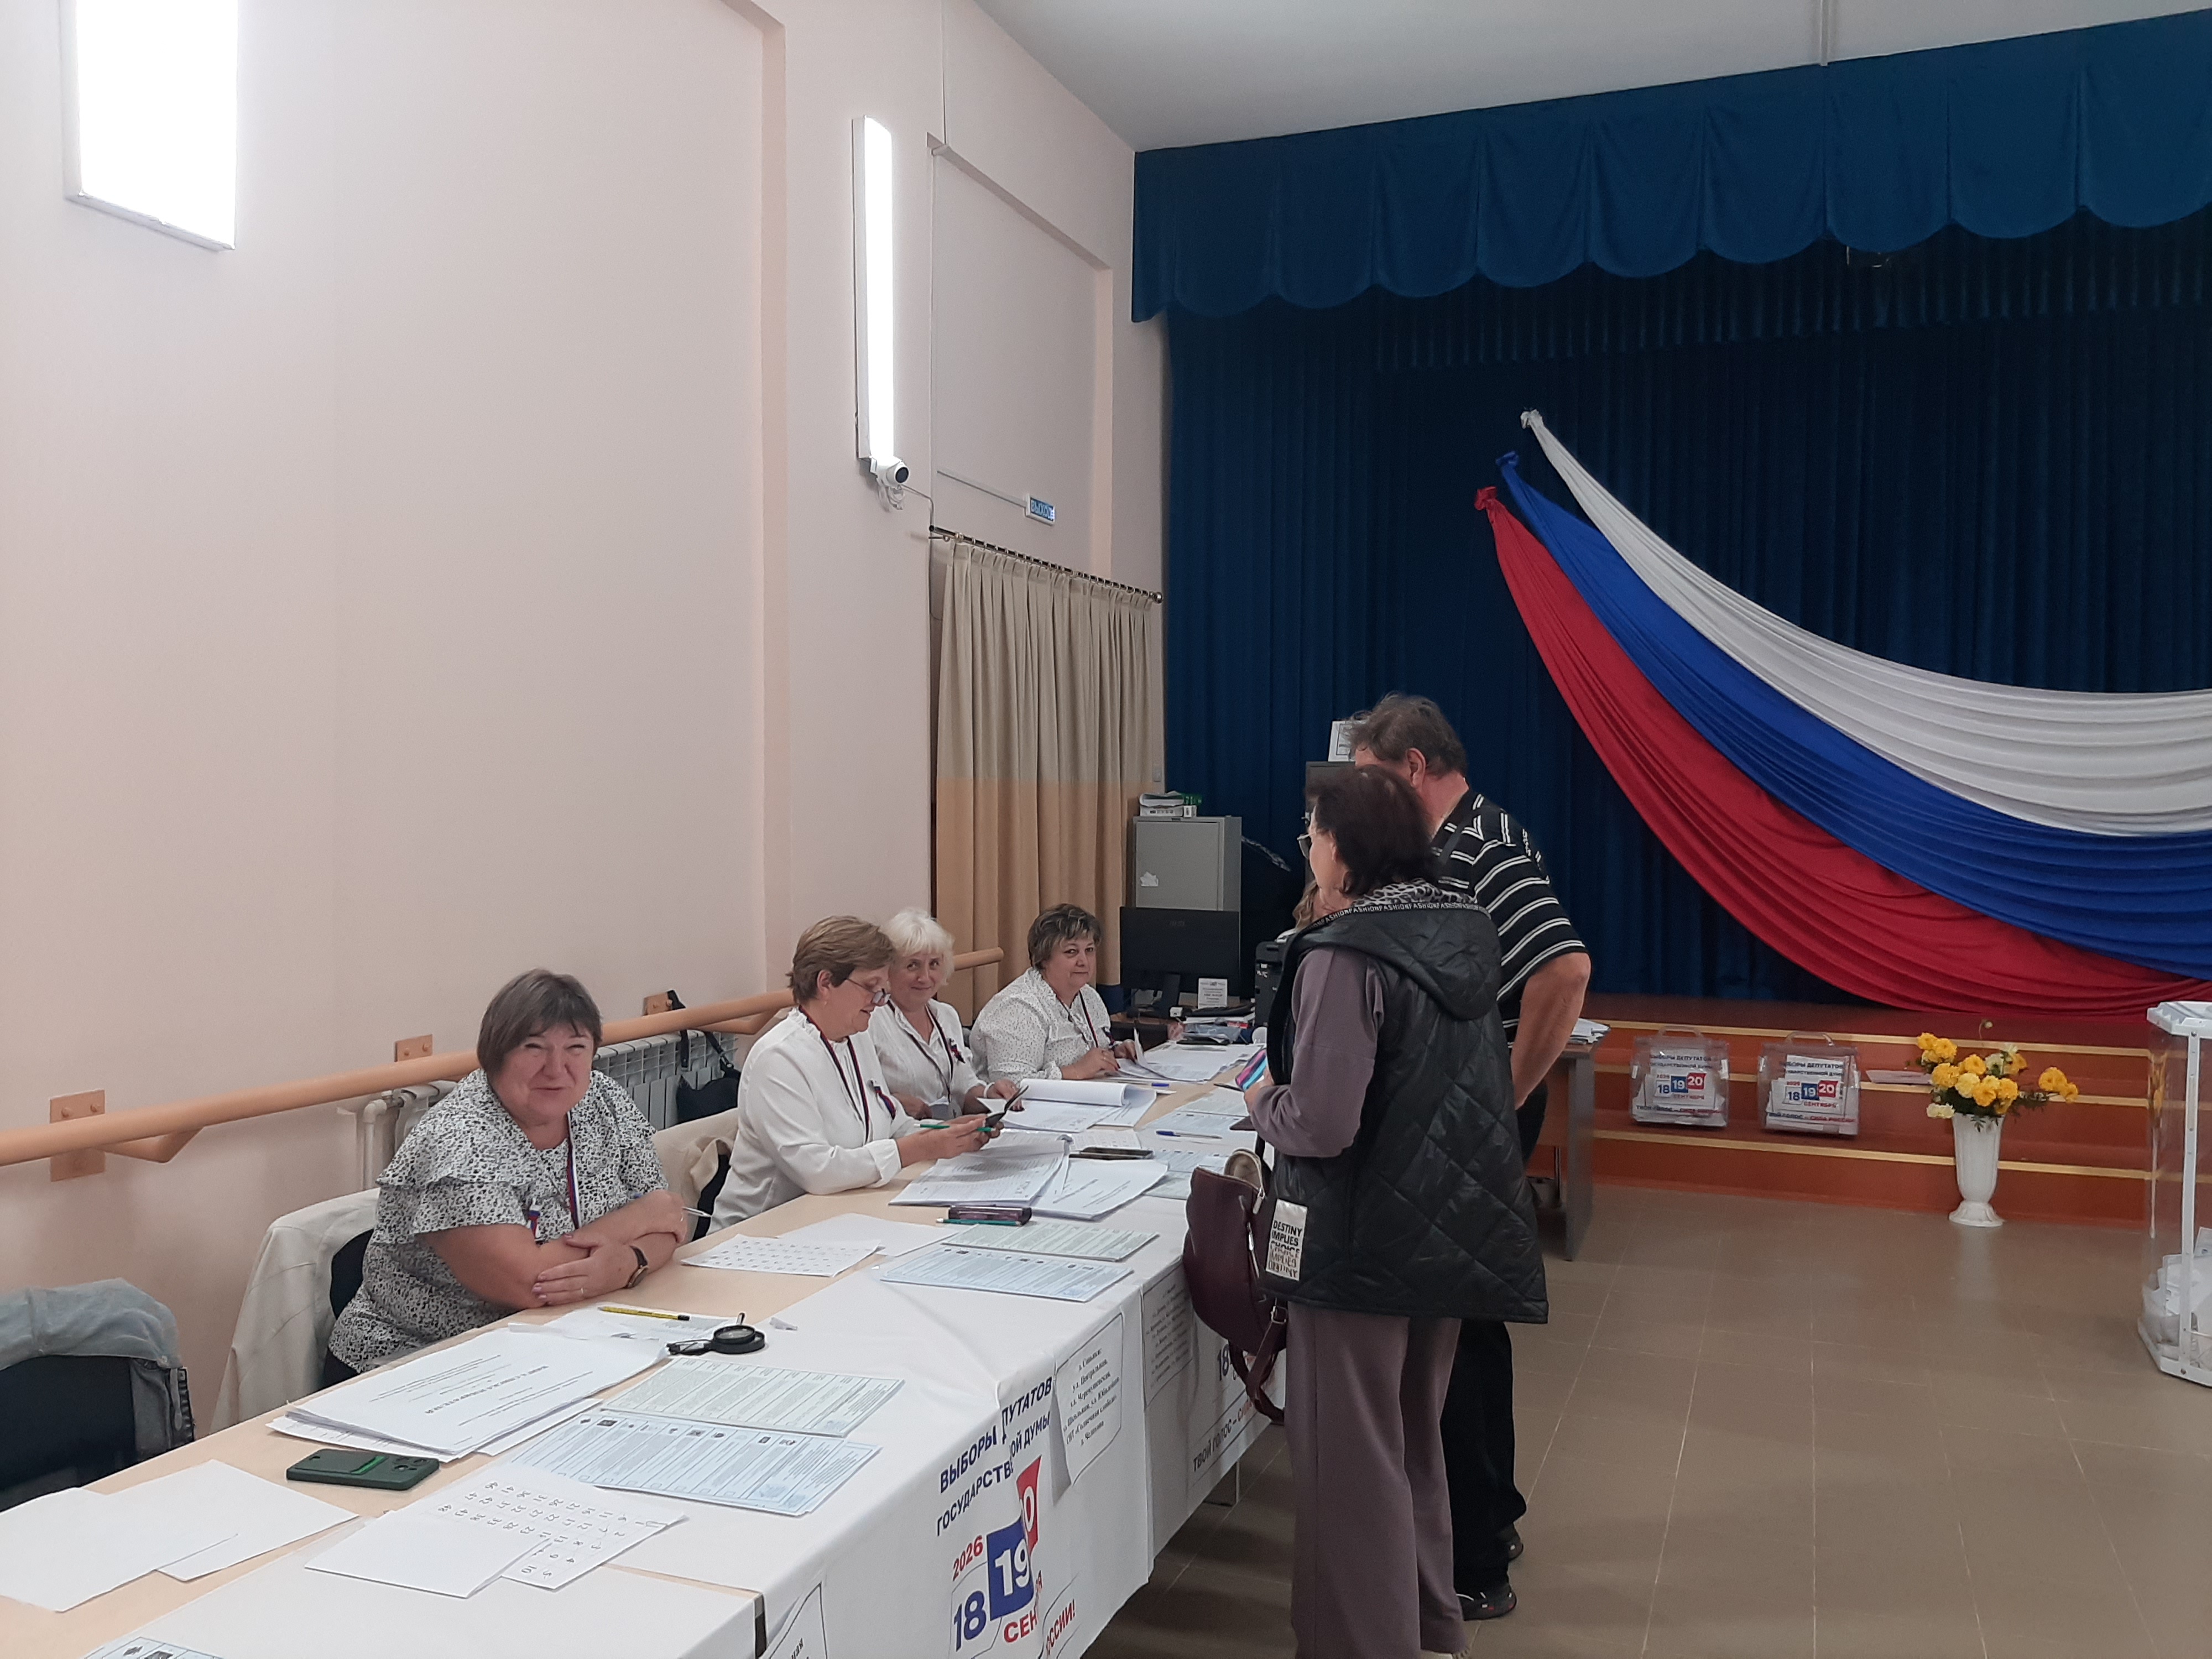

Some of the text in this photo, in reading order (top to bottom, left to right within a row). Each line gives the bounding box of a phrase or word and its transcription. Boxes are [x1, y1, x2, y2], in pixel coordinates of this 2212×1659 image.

[1658, 1077, 1703, 1094] 18 19 20
[1788, 1084, 1835, 1100] 18 19 20
[1273, 1220, 1302, 1237] DESTINY
[1272, 1230, 1298, 1246] IMPLIES
[1217, 1344, 1229, 1381] 18
[940, 1425, 997, 1494] ВЫБОРЫ
[1001, 1376, 1052, 1445] ПУТАТОВ
[937, 1430, 1022, 1537] ГОСУДАРСТВОЙ
[1024, 1411, 1051, 1449] ДУМЫ
[529, 1509, 543, 1517] 27
[952, 1535, 983, 1582] 2026
[521, 1565, 537, 1573] 10
[543, 1569, 552, 1578] 5
[953, 1590, 987, 1652] 18
[995, 1538, 1030, 1597] 19
[1045, 1598, 1076, 1655] ОССИИ!
